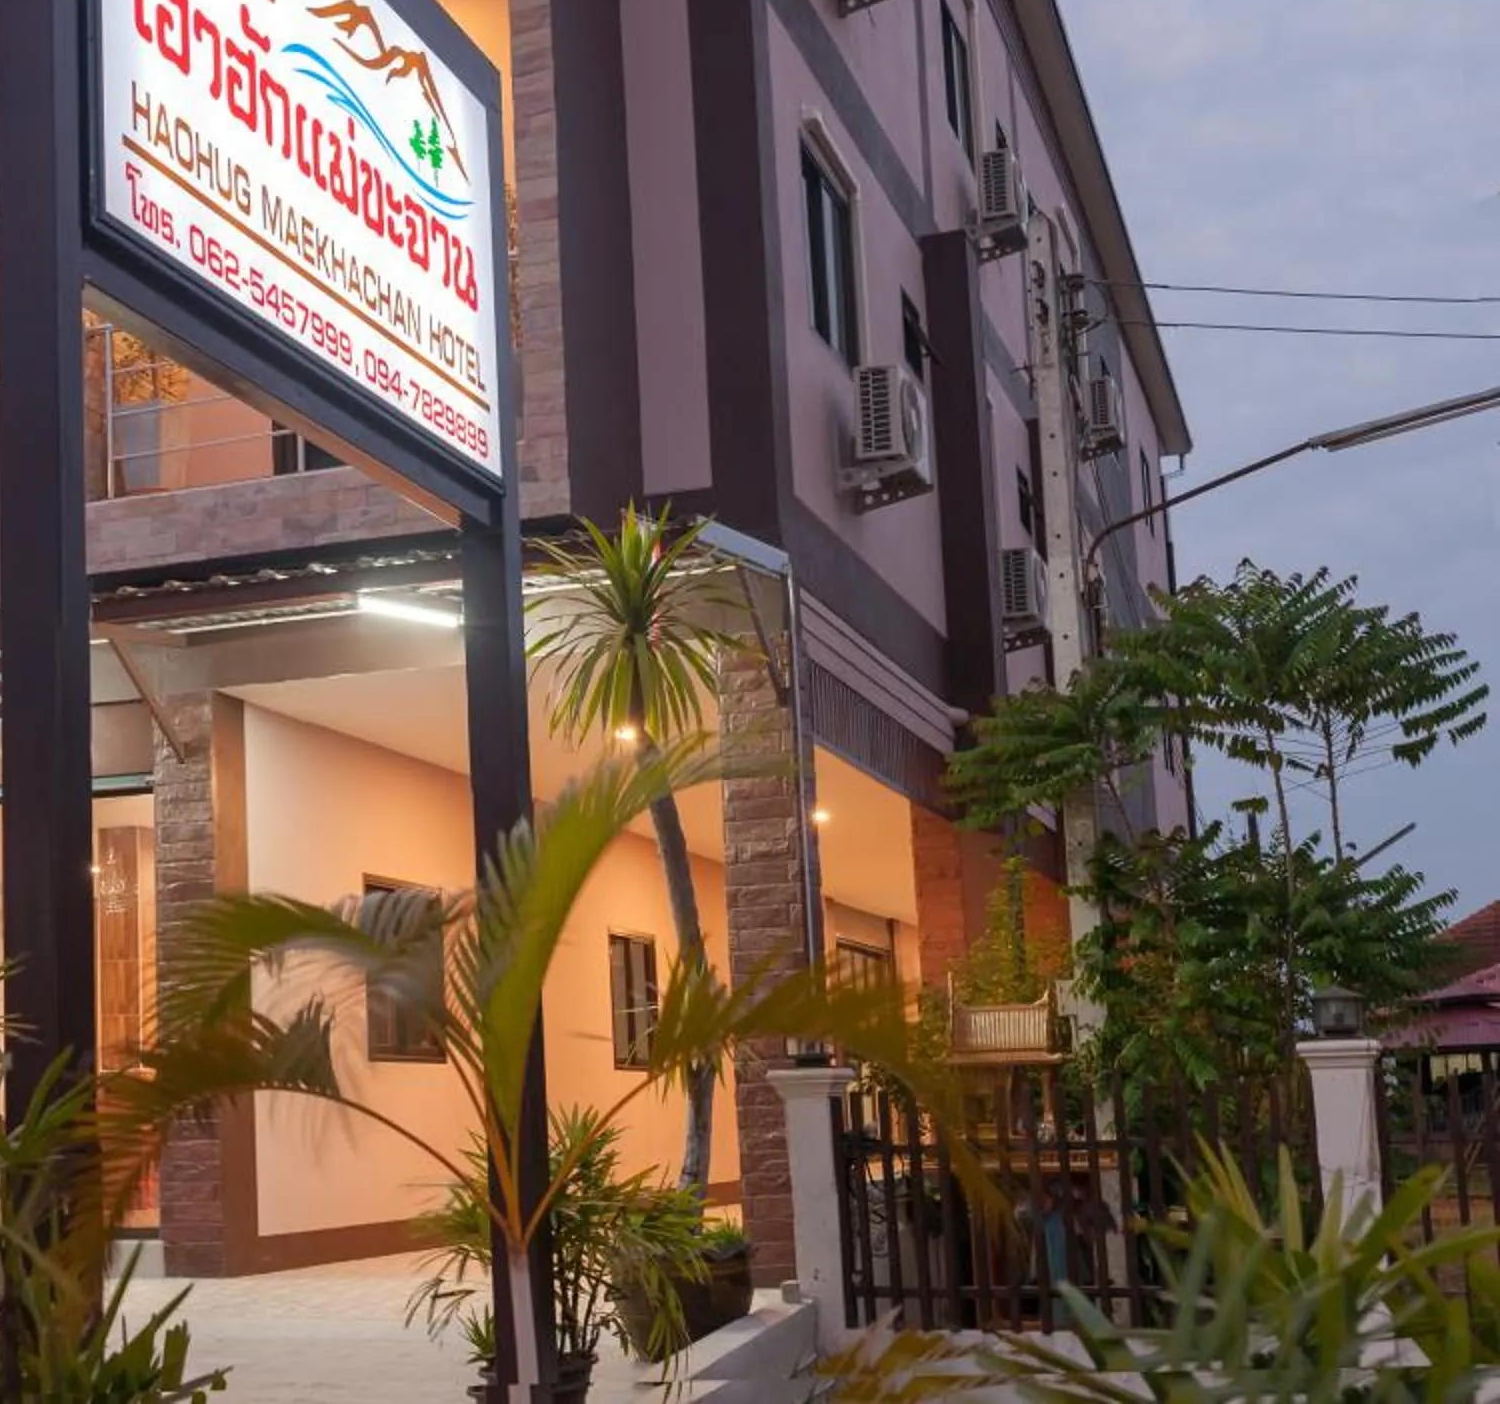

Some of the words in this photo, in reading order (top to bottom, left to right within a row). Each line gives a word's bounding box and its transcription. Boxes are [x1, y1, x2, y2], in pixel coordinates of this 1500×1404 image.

[124, 161, 181, 249] โทร.
[132, 80, 251, 217] HAOHUG
[262, 183, 422, 345] MAEKHACHAN
[429, 315, 486, 392] HOTEL
